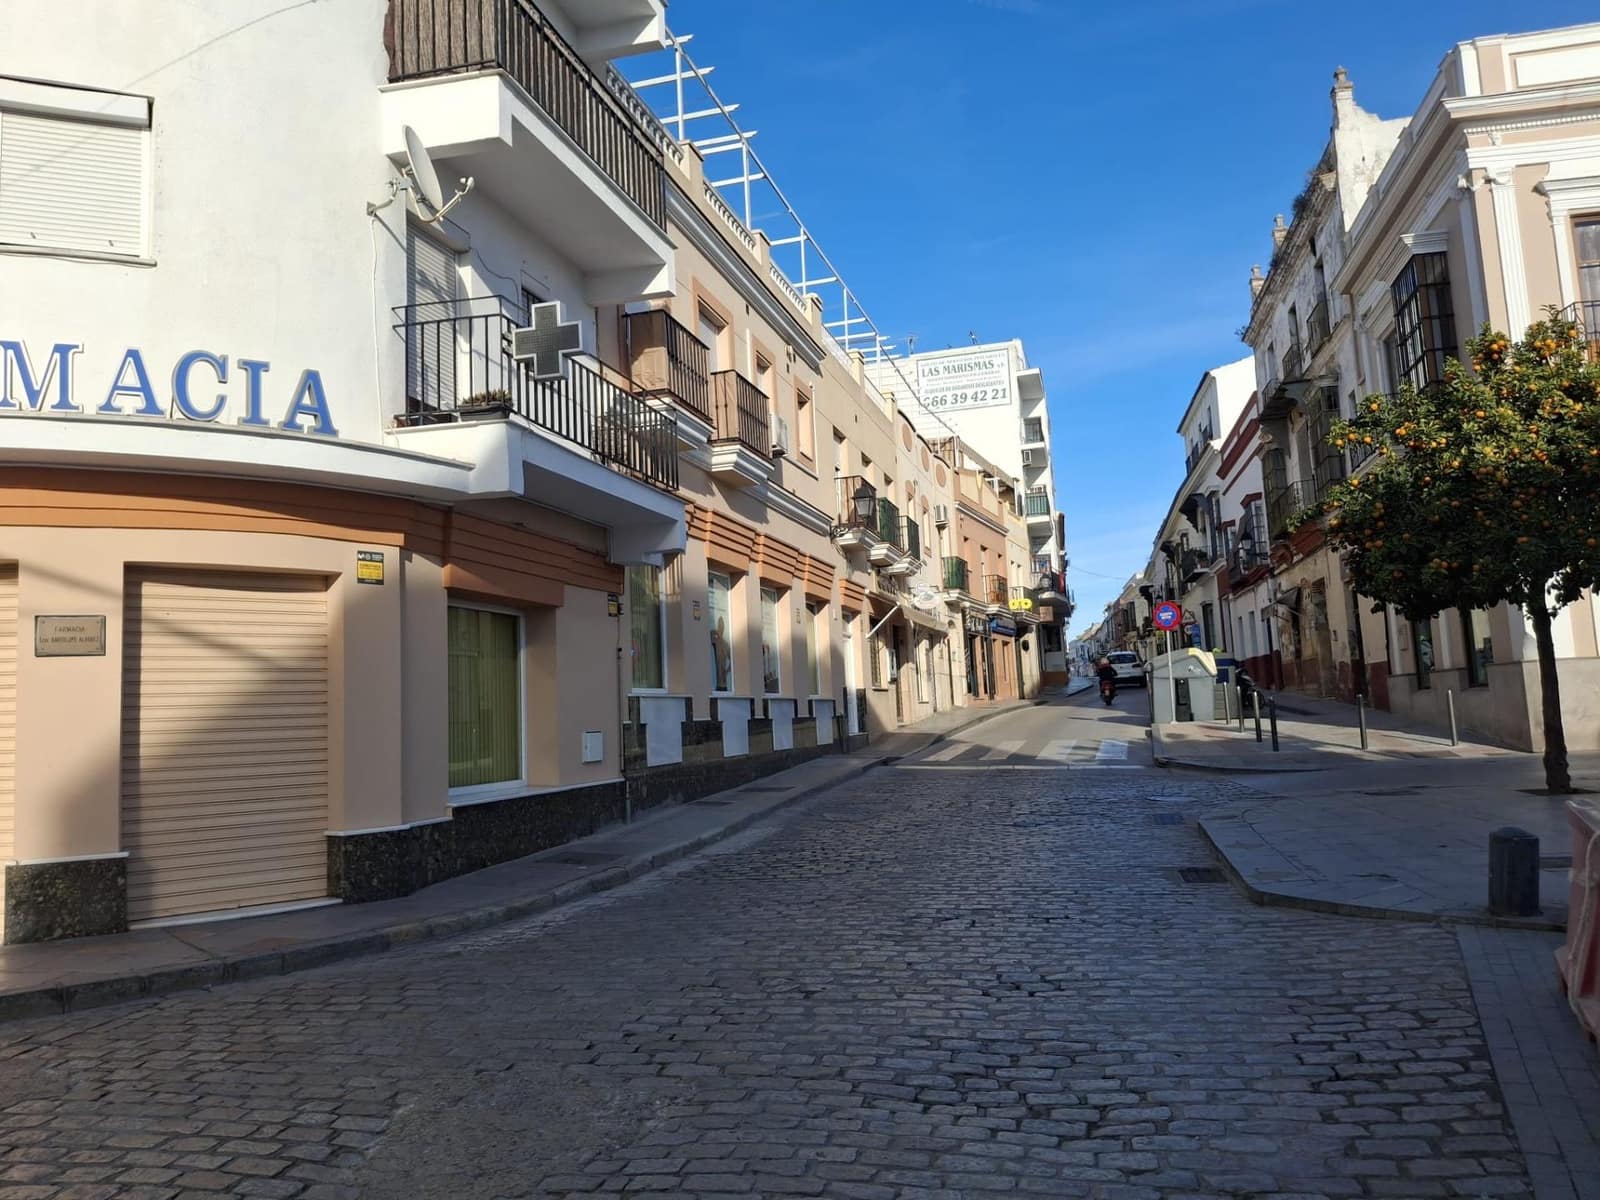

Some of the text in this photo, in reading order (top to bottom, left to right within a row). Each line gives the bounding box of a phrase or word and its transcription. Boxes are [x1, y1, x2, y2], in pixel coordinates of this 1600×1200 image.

[922, 366, 940, 377] LAS
[943, 360, 994, 374] MARISMAS
[0, 340, 338, 437] MACIA
[950, 392, 967, 405] 39
[971, 390, 987, 402] 42
[991, 388, 1007, 400] 21
